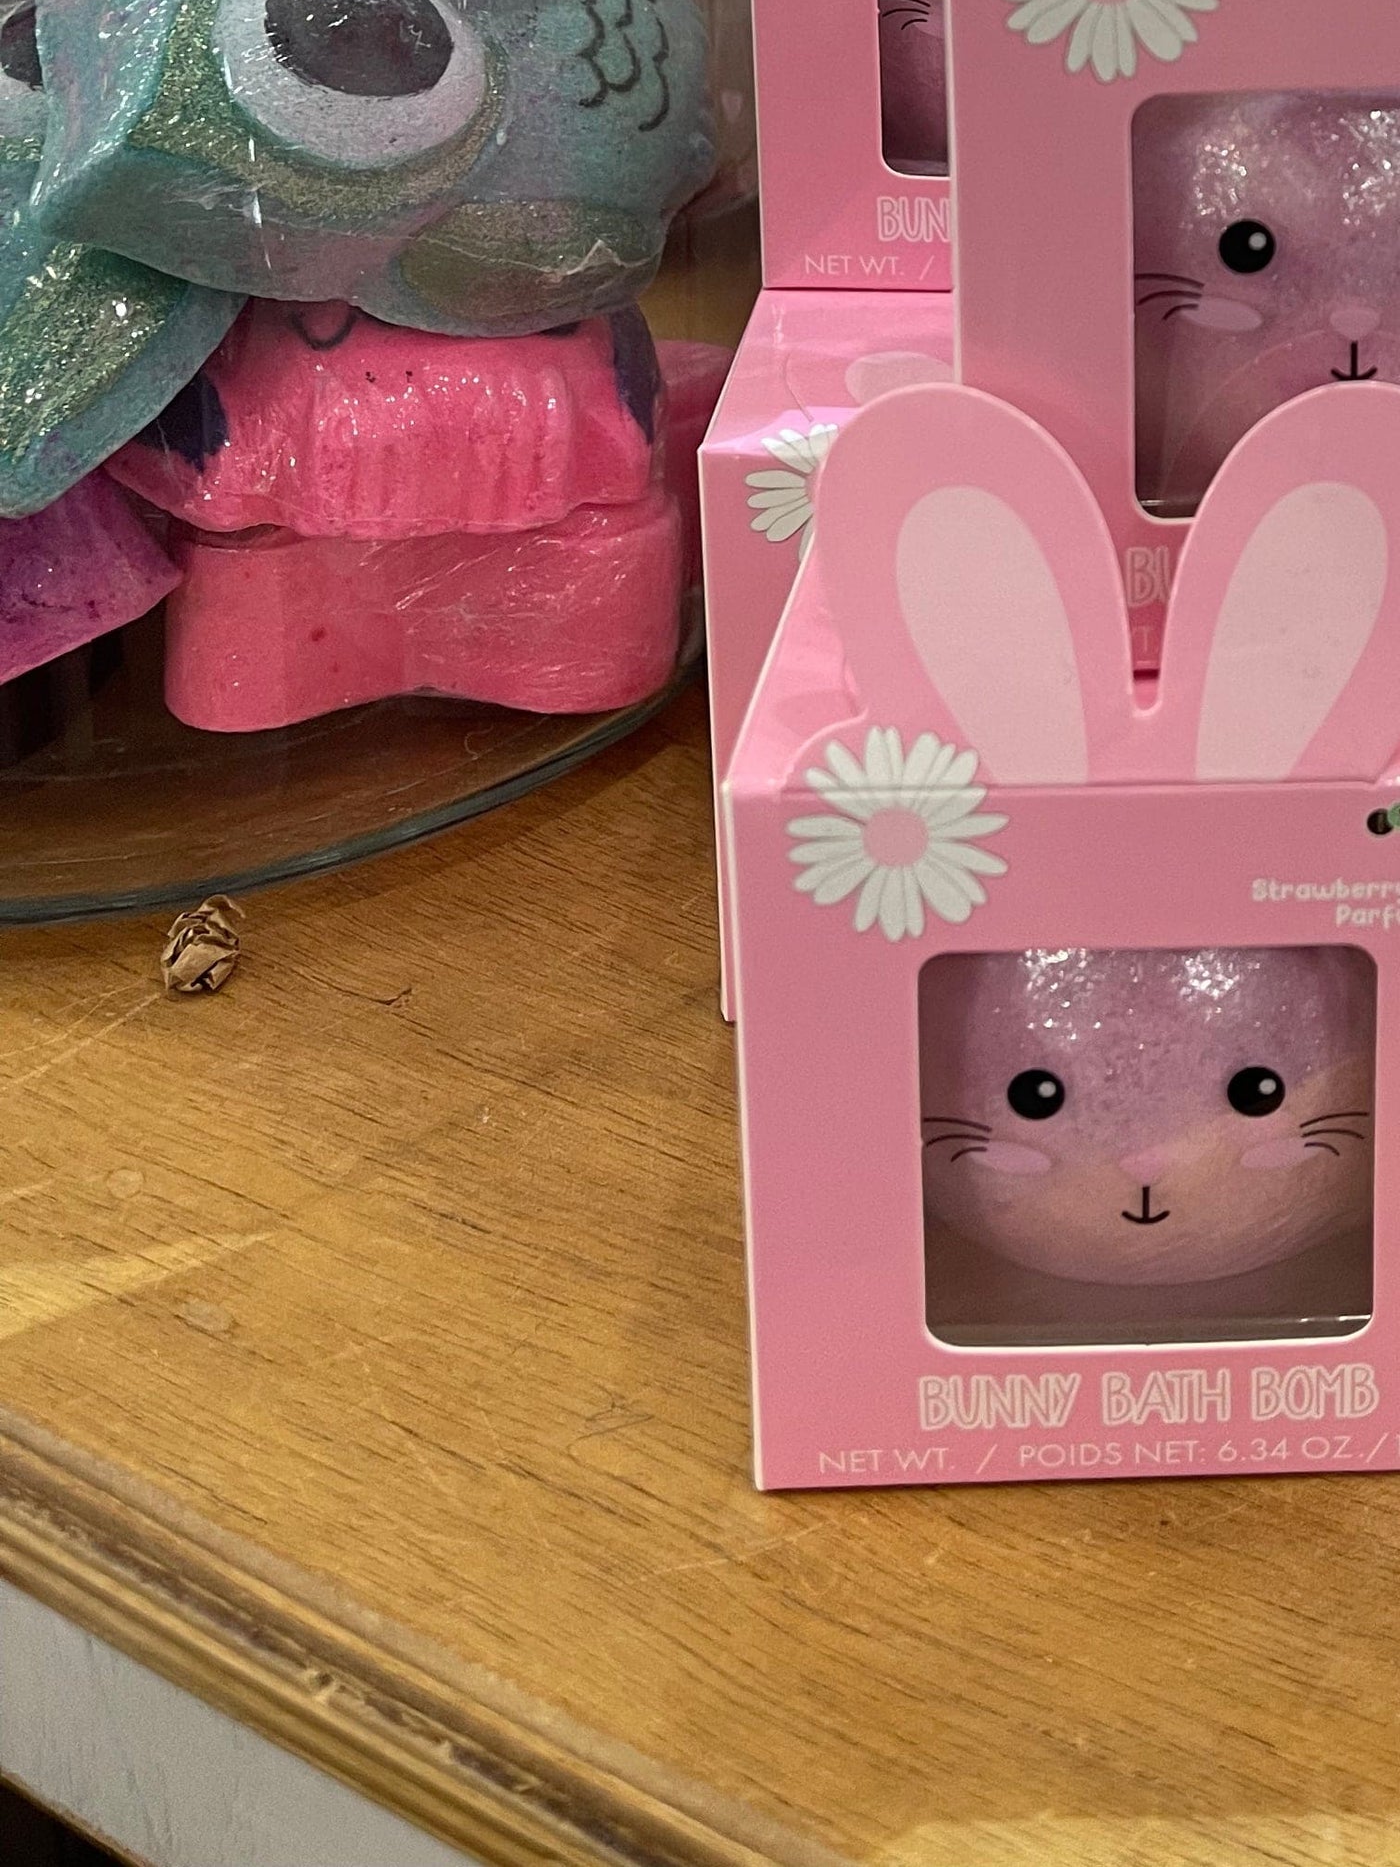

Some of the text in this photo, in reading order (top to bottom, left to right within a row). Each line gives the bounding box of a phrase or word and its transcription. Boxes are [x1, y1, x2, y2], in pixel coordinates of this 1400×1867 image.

[877, 196, 950, 242] BUN
[805, 254, 852, 275] NET
[860, 255, 904, 276] WT.
[919, 1363, 1380, 1431] BUNNY BATH BOMB
[818, 1448, 882, 1474] NET
[893, 1447, 955, 1472] WT.
[1019, 1441, 1121, 1467] POIDS
[1218, 1437, 1289, 1463] 6.34
